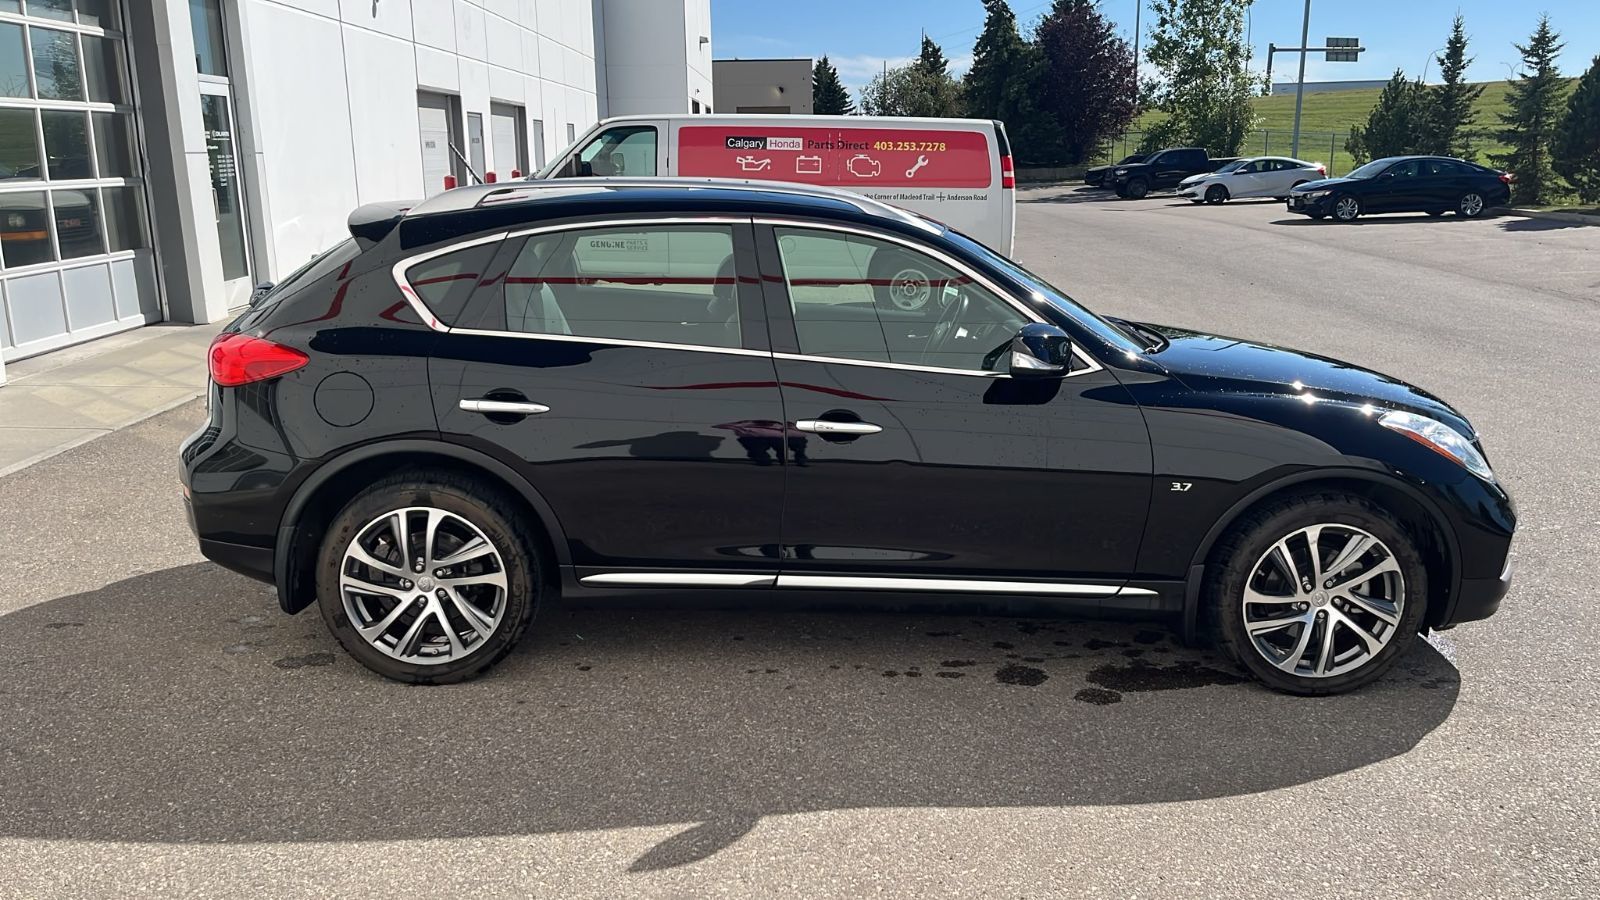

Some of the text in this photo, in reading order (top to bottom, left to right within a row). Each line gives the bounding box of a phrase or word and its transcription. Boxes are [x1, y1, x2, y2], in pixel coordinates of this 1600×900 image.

[727, 138, 946, 151] Calgary Honda Parts Direct 403.253.7278
[1170, 482, 1193, 491] 3.7
